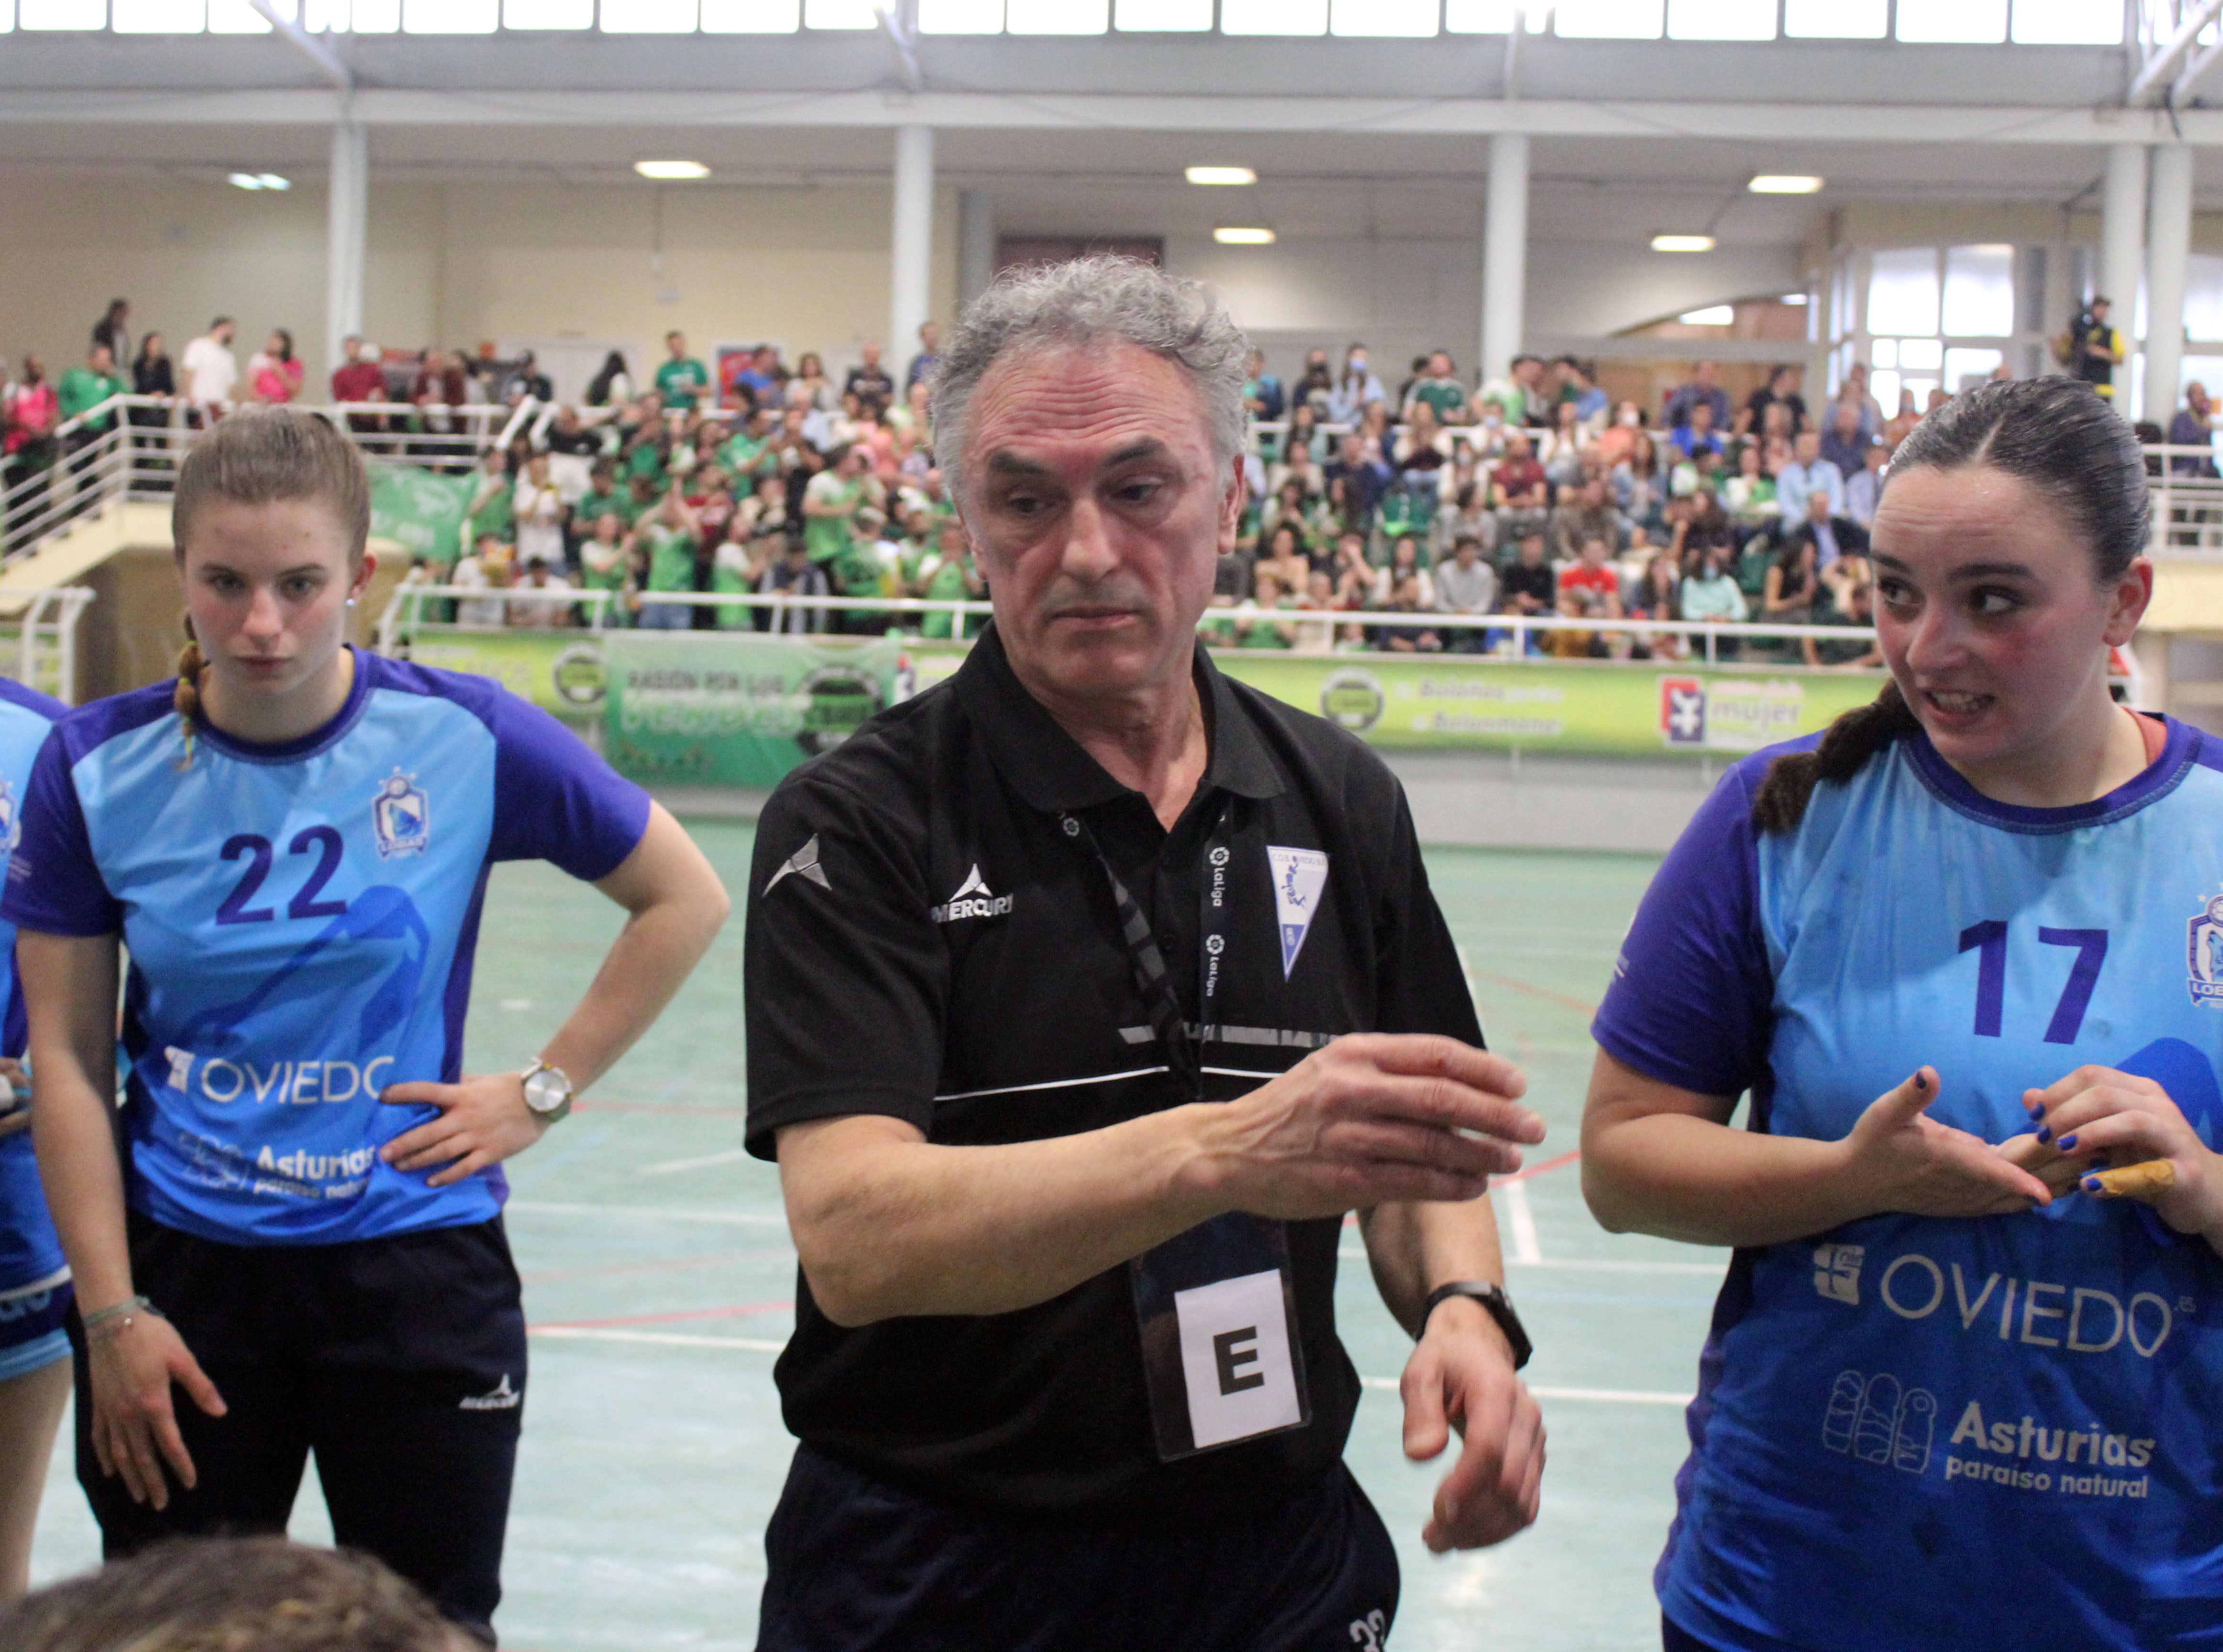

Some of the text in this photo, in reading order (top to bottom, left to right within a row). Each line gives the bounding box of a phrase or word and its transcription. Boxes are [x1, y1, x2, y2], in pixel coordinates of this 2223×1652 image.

[216, 825, 347, 925] 22
[1210, 868, 1225, 907] LaLiga
[1958, 919, 2108, 1044] 17
[1881, 1254, 2171, 1358] OVIEDO
[1213, 1326, 1264, 1396] E
[1950, 1400, 2155, 1467] Asturias
[2060, 1476, 2148, 1499] natural
